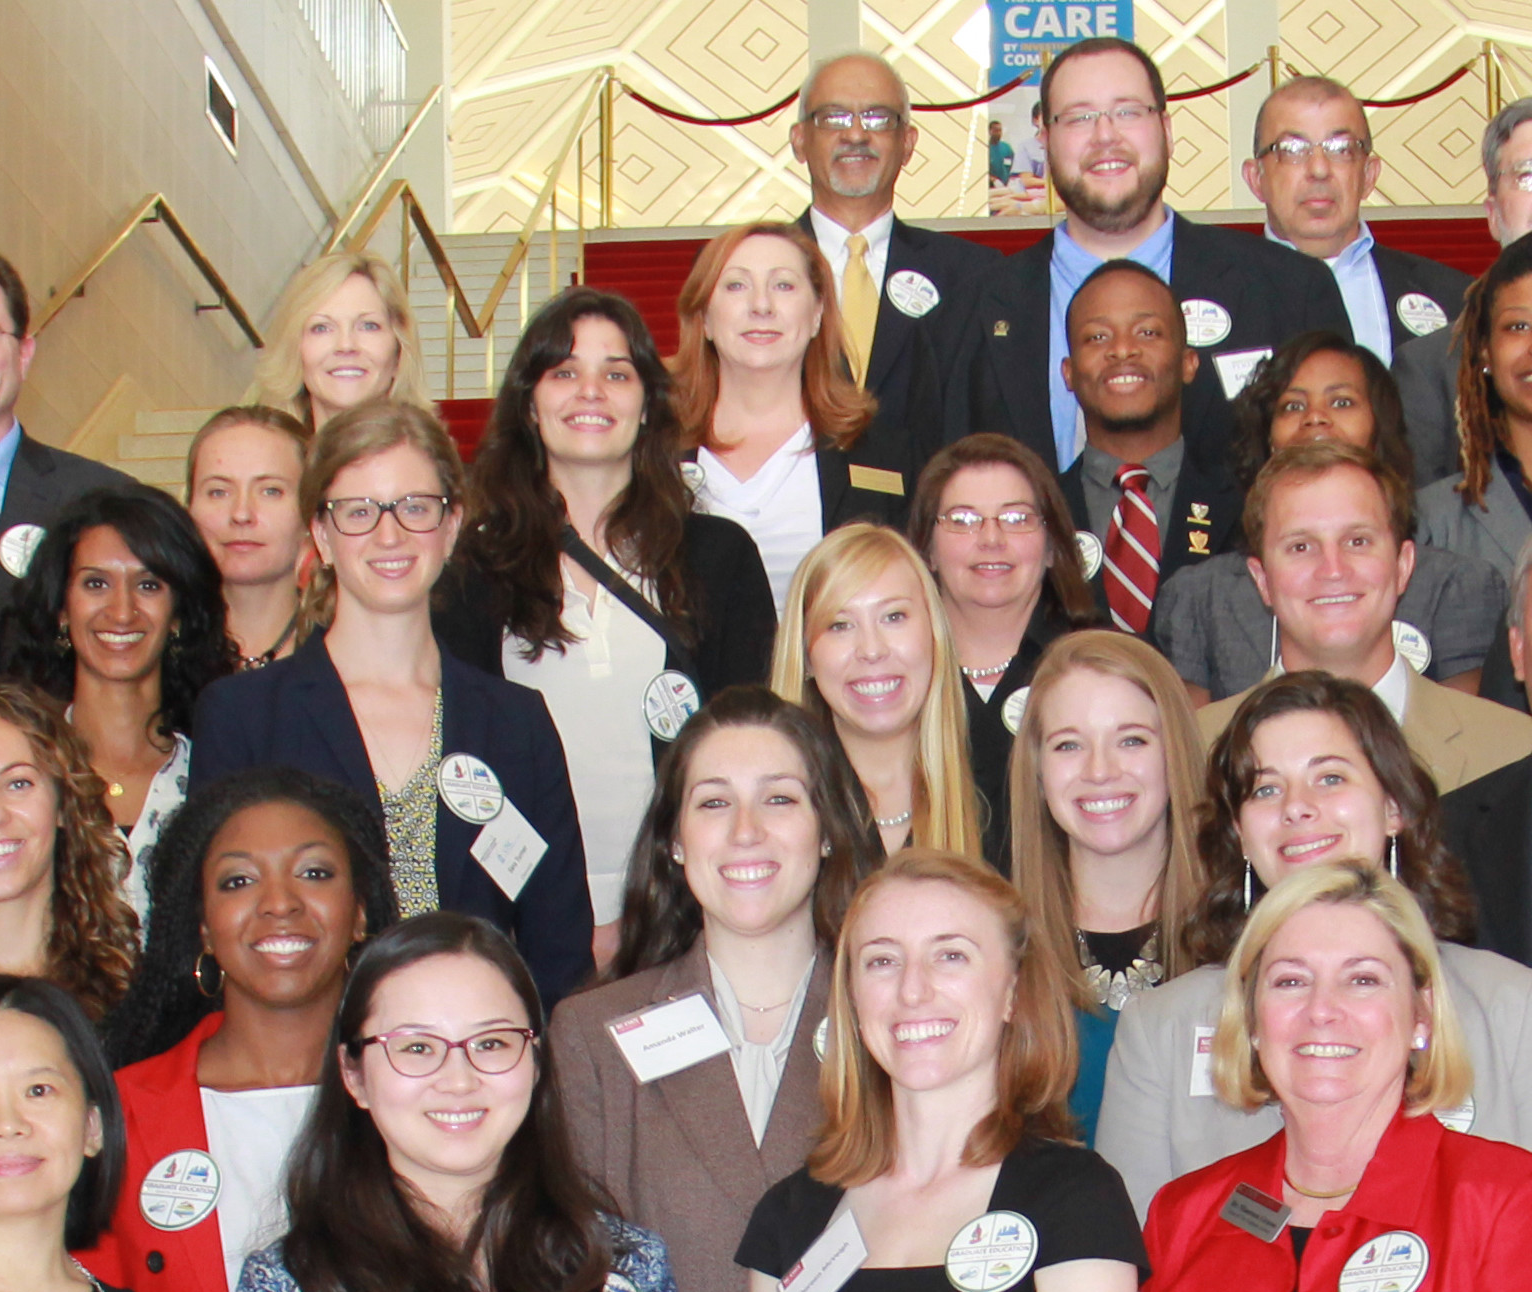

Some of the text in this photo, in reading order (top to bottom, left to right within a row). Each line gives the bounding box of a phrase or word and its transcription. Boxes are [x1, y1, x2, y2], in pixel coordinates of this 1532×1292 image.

[1004, 4, 1119, 38] CARE
[1003, 43, 1018, 52] BY
[988, 1245, 1031, 1254] EDUCATION
